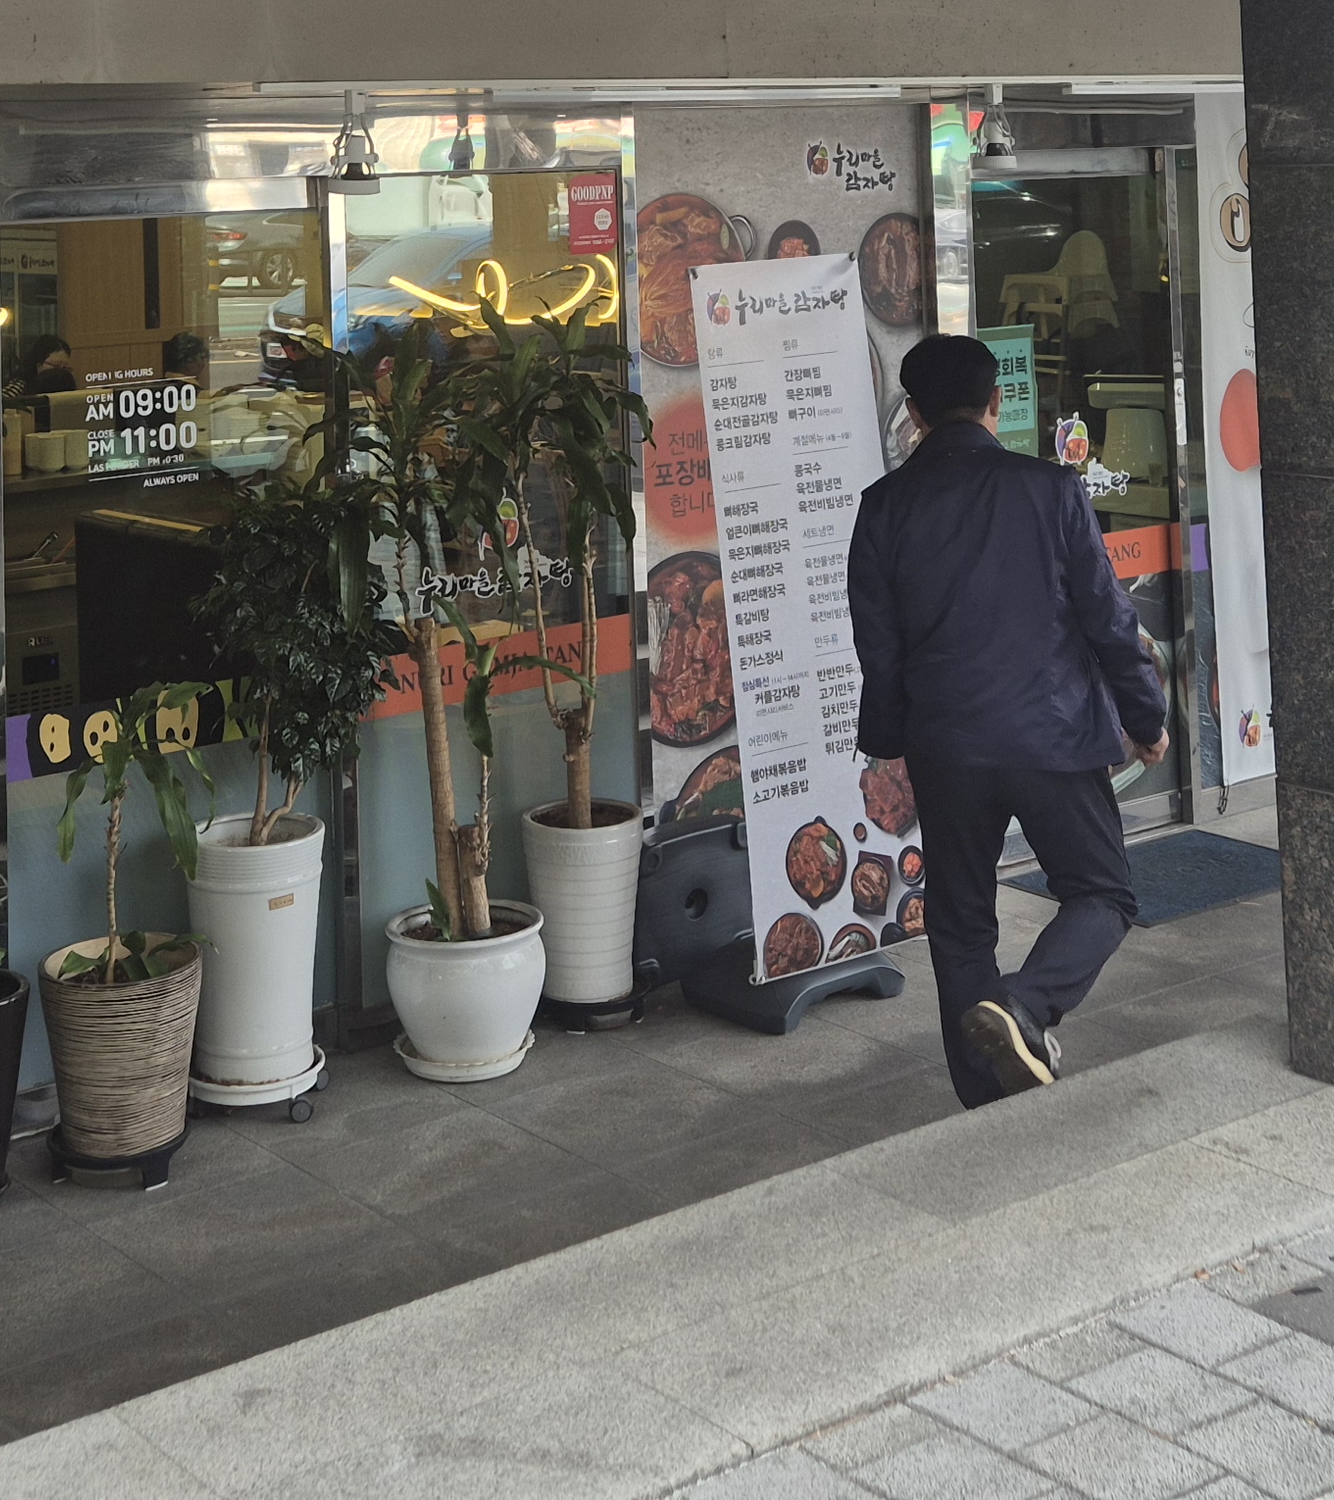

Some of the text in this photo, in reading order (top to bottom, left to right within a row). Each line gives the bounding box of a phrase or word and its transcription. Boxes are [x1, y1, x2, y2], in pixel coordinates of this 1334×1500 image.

[832, 142, 885, 178] 누리마을
[845, 171, 896, 192] 감자탕
[735, 287, 848, 325] 누리마을 감자탕
[124, 367, 154, 379] HOURS
[709, 376, 737, 392] 감자탕
[1000, 381, 1031, 403] 쿠폰
[85, 383, 197, 422] AM 09:00
[86, 392, 114, 404] OPEN
[711, 392, 768, 411] 묵은지감자탕
[713, 410, 779, 432] 순대전골감자탕
[87, 428, 115, 440] CLOSE
[88, 421, 197, 458] PM 11:00
[669, 429, 708, 456] 전메
[716, 431, 772, 452] 콩크림감자탕
[143, 472, 199, 488] ALWAYS OPEN
[721, 470, 745, 485] 식사류
[796, 476, 843, 495] 육전물냉면
[723, 501, 759, 519] 뼈해장국
[798, 493, 854, 513] 육전비빔냉면
[725, 518, 788, 541] 얼큰이뼈해장국
[802, 524, 835, 540] 세트냉면
[728, 539, 791, 562] 묵은지뼈해장국
[730, 561, 784, 584] 순대뼈해장국
[732, 583, 787, 605] 뼈라면해장국
[735, 607, 770, 627] 특갈비탕
[737, 629, 772, 649] 특해장국
[814, 633, 839, 649] 만두류
[739, 649, 784, 671] 돈가스정식
[401, 663, 454, 694] NRI
[816, 663, 854, 682] 반반만두
[754, 683, 800, 706] 커플감자탕
[818, 681, 857, 700] 고기만두
[820, 699, 859, 719] 김치만두
[747, 729, 789, 748] 어린이메뉴
[751, 757, 807, 783] 햄야채볶음밥
[752, 779, 809, 804] 소고기볶음밥
